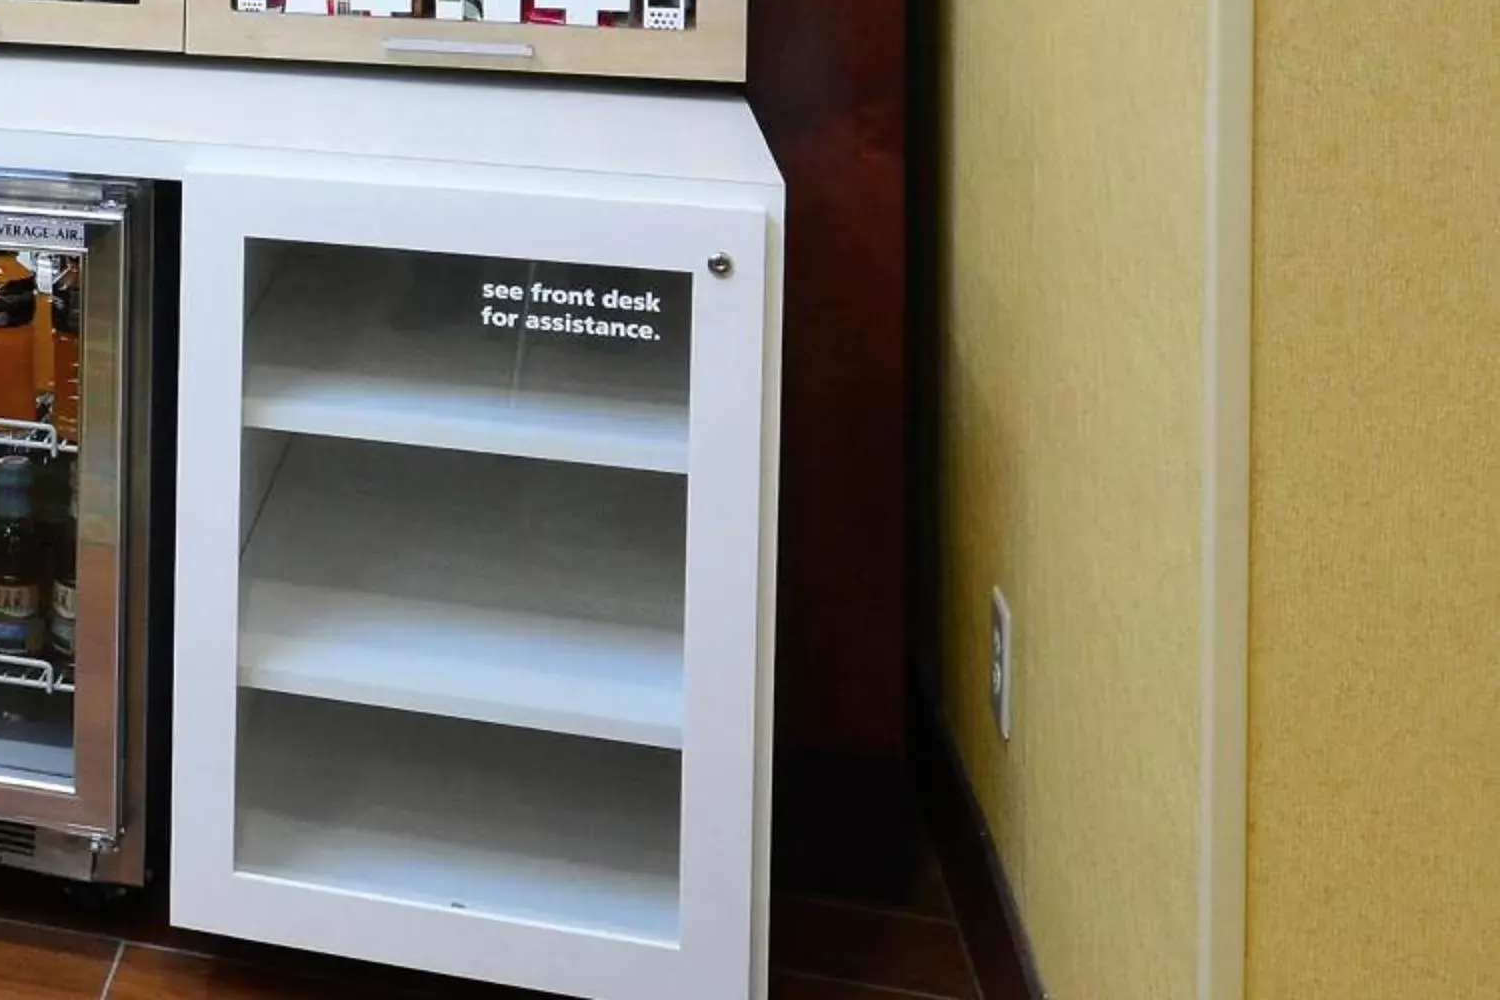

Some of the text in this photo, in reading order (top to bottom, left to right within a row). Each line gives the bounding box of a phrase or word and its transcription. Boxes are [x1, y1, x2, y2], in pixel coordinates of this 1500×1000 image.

[481, 281, 662, 313] see front desk
[480, 305, 662, 341] for assistance.
